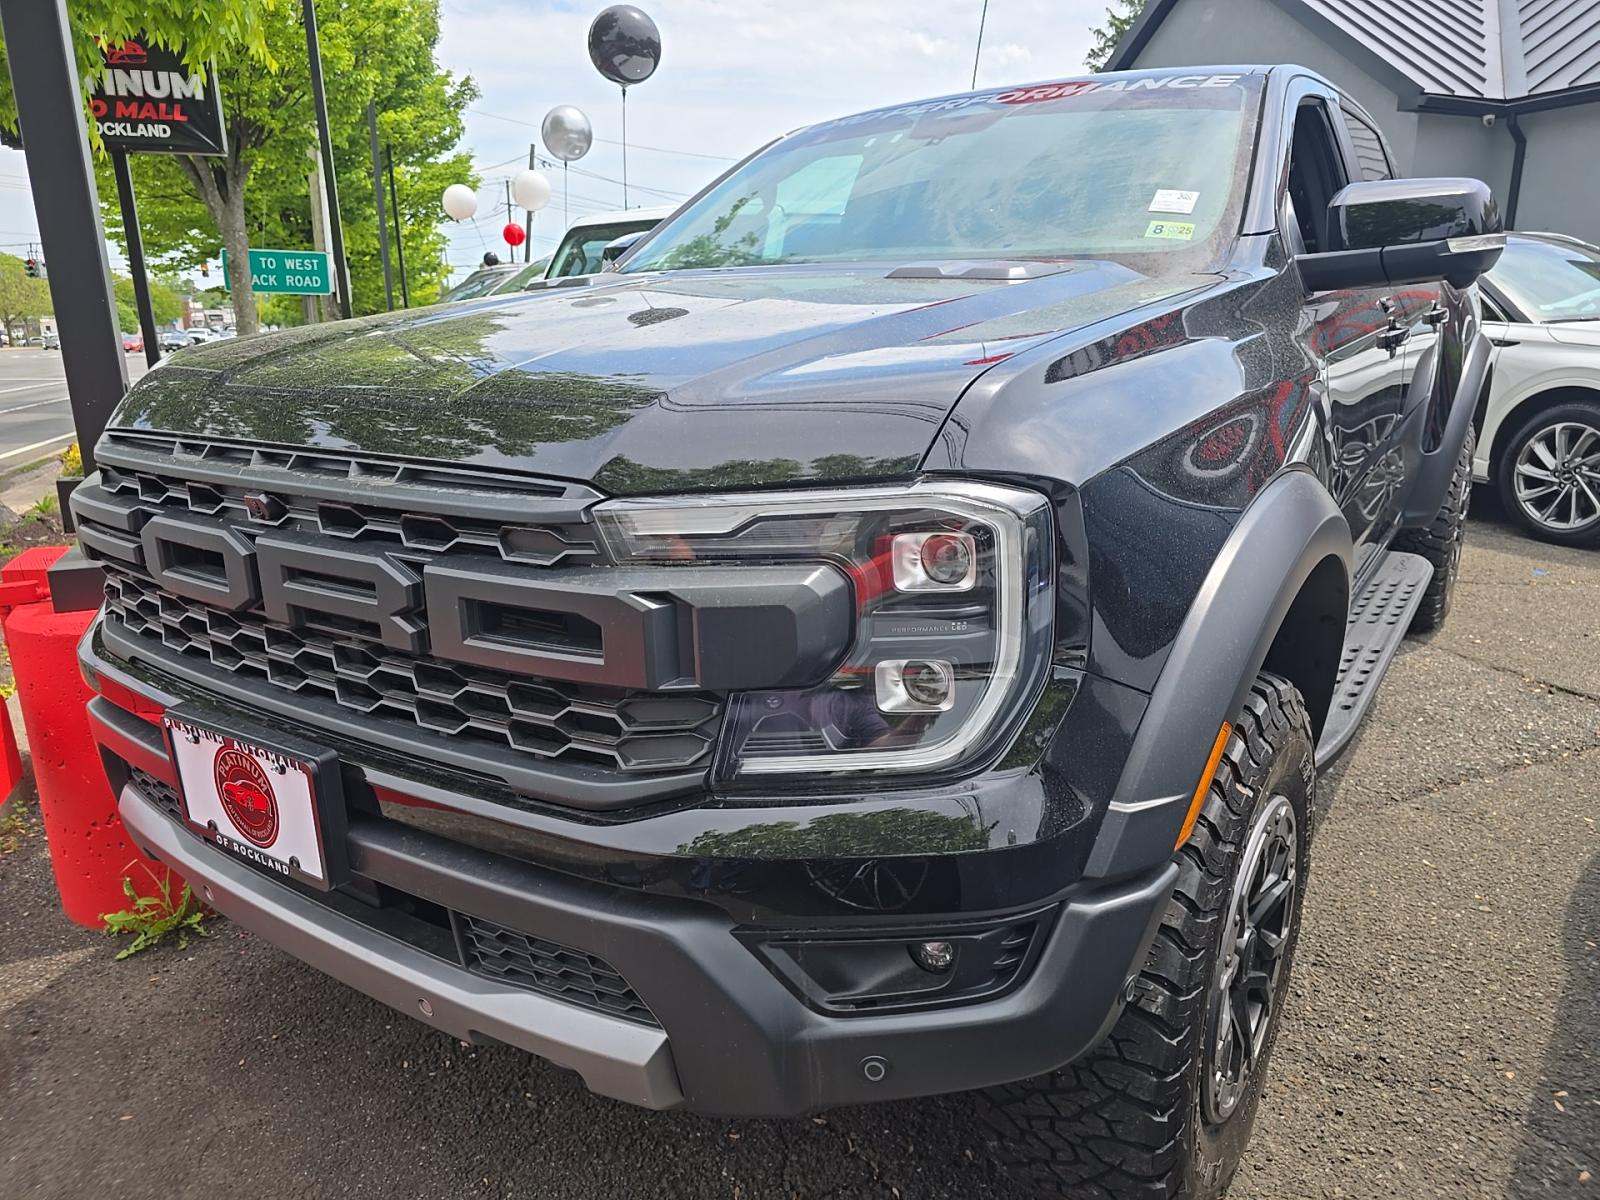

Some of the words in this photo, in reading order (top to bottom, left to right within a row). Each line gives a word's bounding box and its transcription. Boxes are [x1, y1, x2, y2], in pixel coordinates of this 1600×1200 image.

[115, 101, 188, 122] MALL
[881, 75, 1241, 119] PERFORMANCE
[1153, 225, 1164, 234] 8
[1177, 226, 1192, 235] 25
[259, 257, 276, 269] TO
[285, 258, 319, 270] WEST
[285, 275, 321, 287] ROAD
[164, 717, 224, 745] PLATINUM
[233, 740, 303, 774] AUTOMALL
[219, 753, 269, 792] PLATINUM
[216, 834, 229, 847] OF
[233, 843, 290, 875] ROCKLAND
